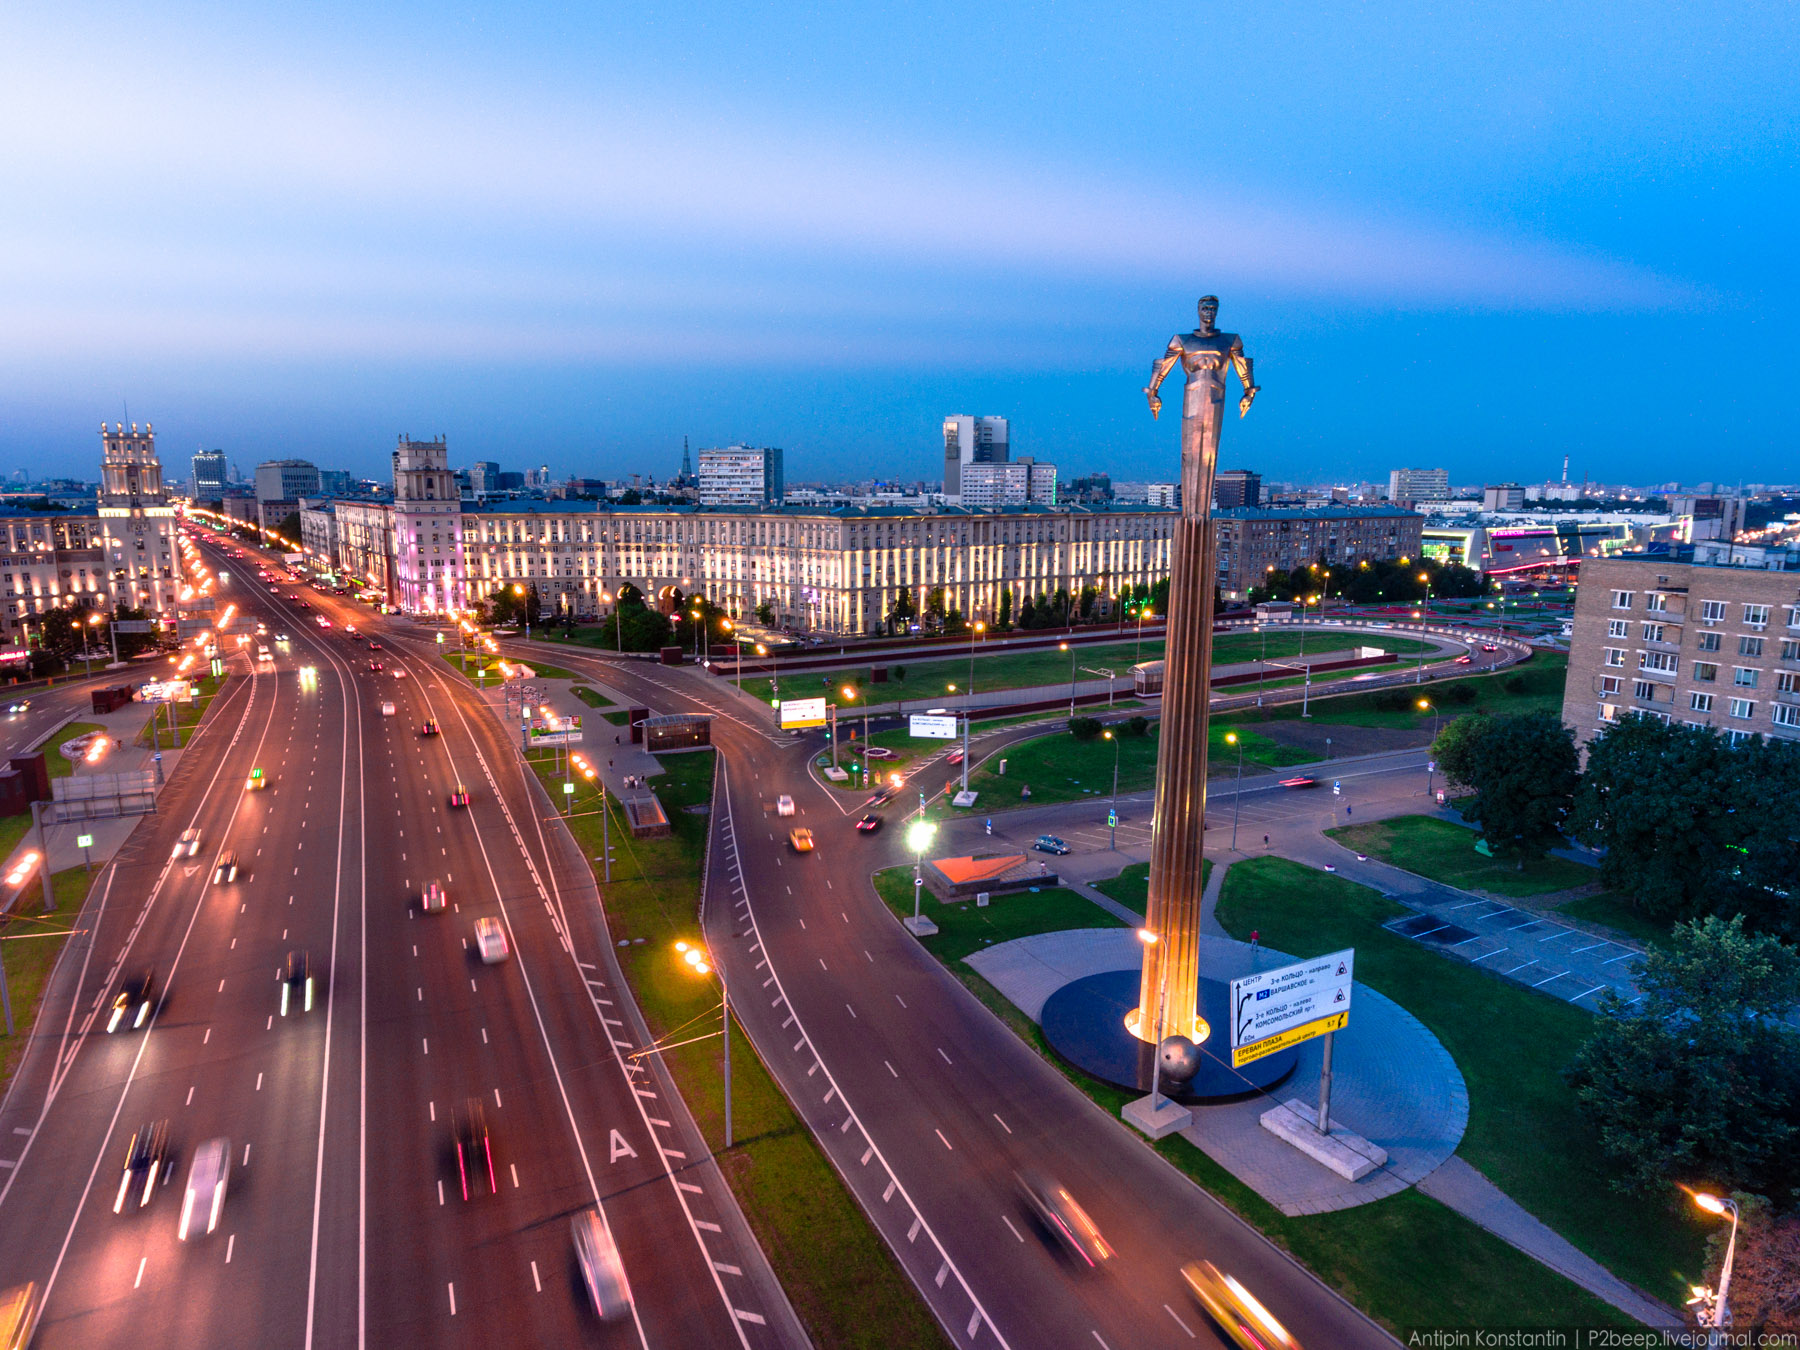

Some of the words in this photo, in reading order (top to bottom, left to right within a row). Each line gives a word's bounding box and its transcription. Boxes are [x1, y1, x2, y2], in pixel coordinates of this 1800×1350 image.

[1243, 976, 1262, 986] ЦЕНТР
[1281, 970, 1304, 981] КОЛЬЦО
[1309, 964, 1331, 974] направо
[1271, 979, 1307, 995] ВАРШАВСКОЕ
[1266, 1004, 1288, 1017] КОЛЬЦО
[1293, 998, 1312, 1007] налево
[1256, 1007, 1303, 1029] КОМСОМОЛЬСКИЙ
[1238, 1044, 1262, 1057] ЕРЕВАН
[1263, 1036, 1283, 1049] ПЛАЗА
[1238, 1036, 1302, 1063] торгово-развлекательный
[1302, 1031, 1316, 1039] центр
